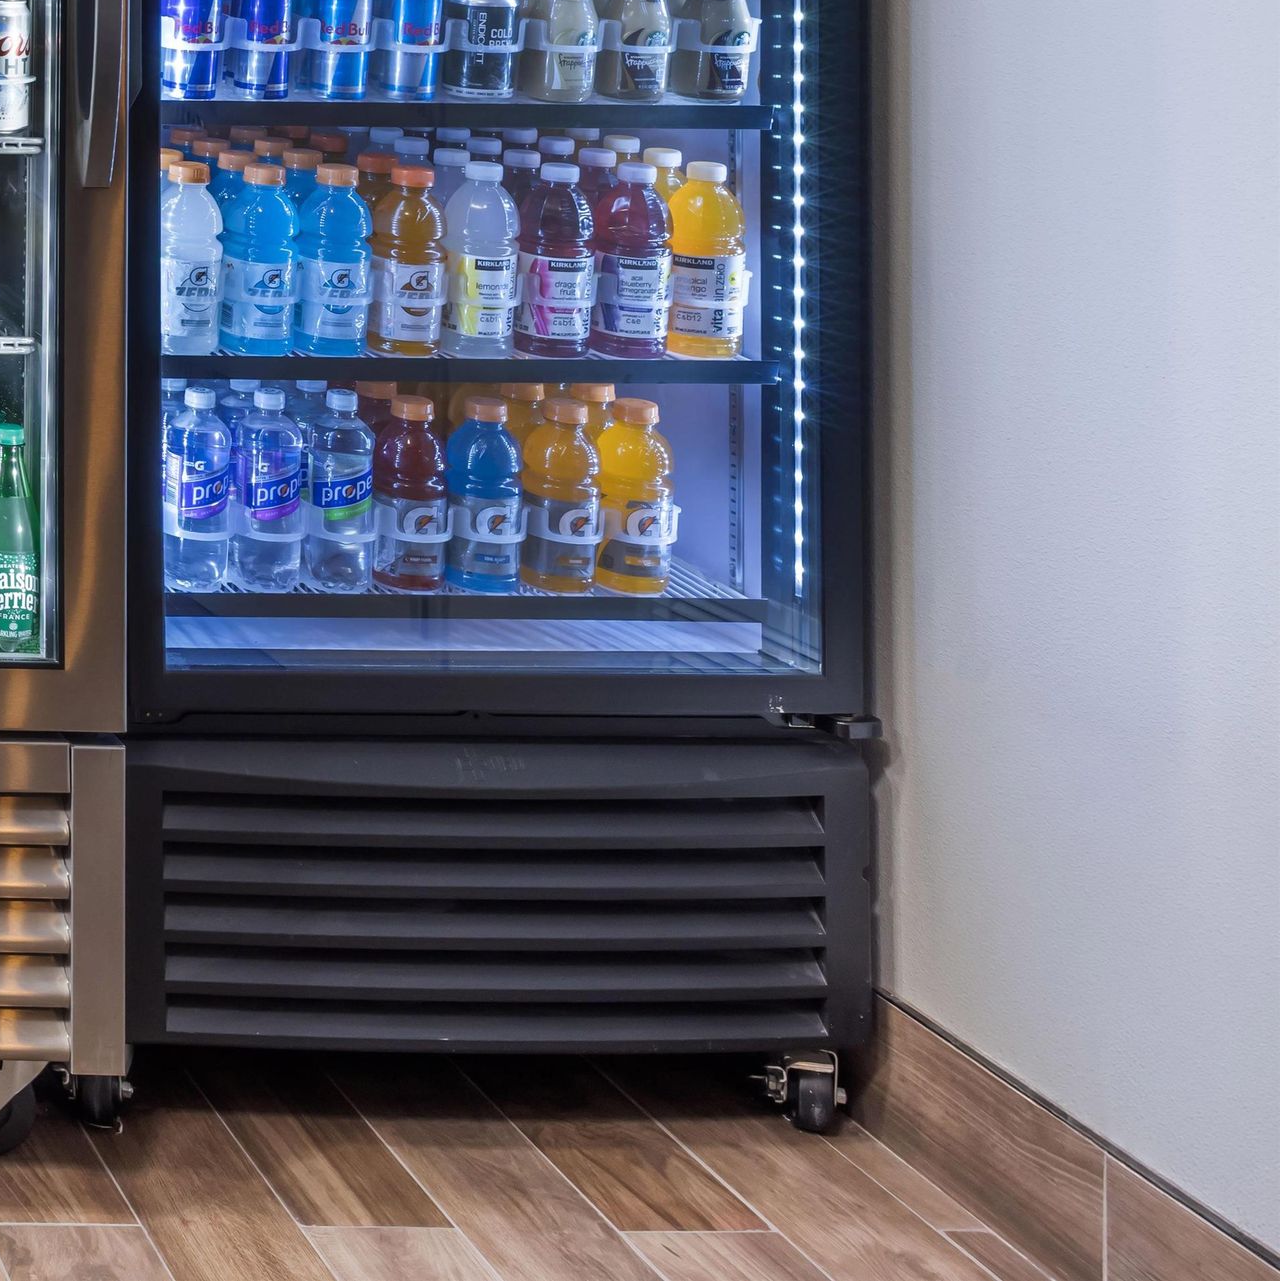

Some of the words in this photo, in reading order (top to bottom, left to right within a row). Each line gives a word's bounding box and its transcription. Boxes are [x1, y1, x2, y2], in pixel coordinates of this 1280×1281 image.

[476, 260, 510, 269] KIRKLAND
[550, 261, 587, 270] KIRKLAND
[618, 258, 657, 267] KIRKLAND
[674, 256, 713, 266] KIRKLAND
[620, 280, 652, 289] blueberry
[403, 506, 439, 535] G
[476, 506, 513, 536] G
[559, 508, 594, 538] G
[627, 508, 662, 537] G
